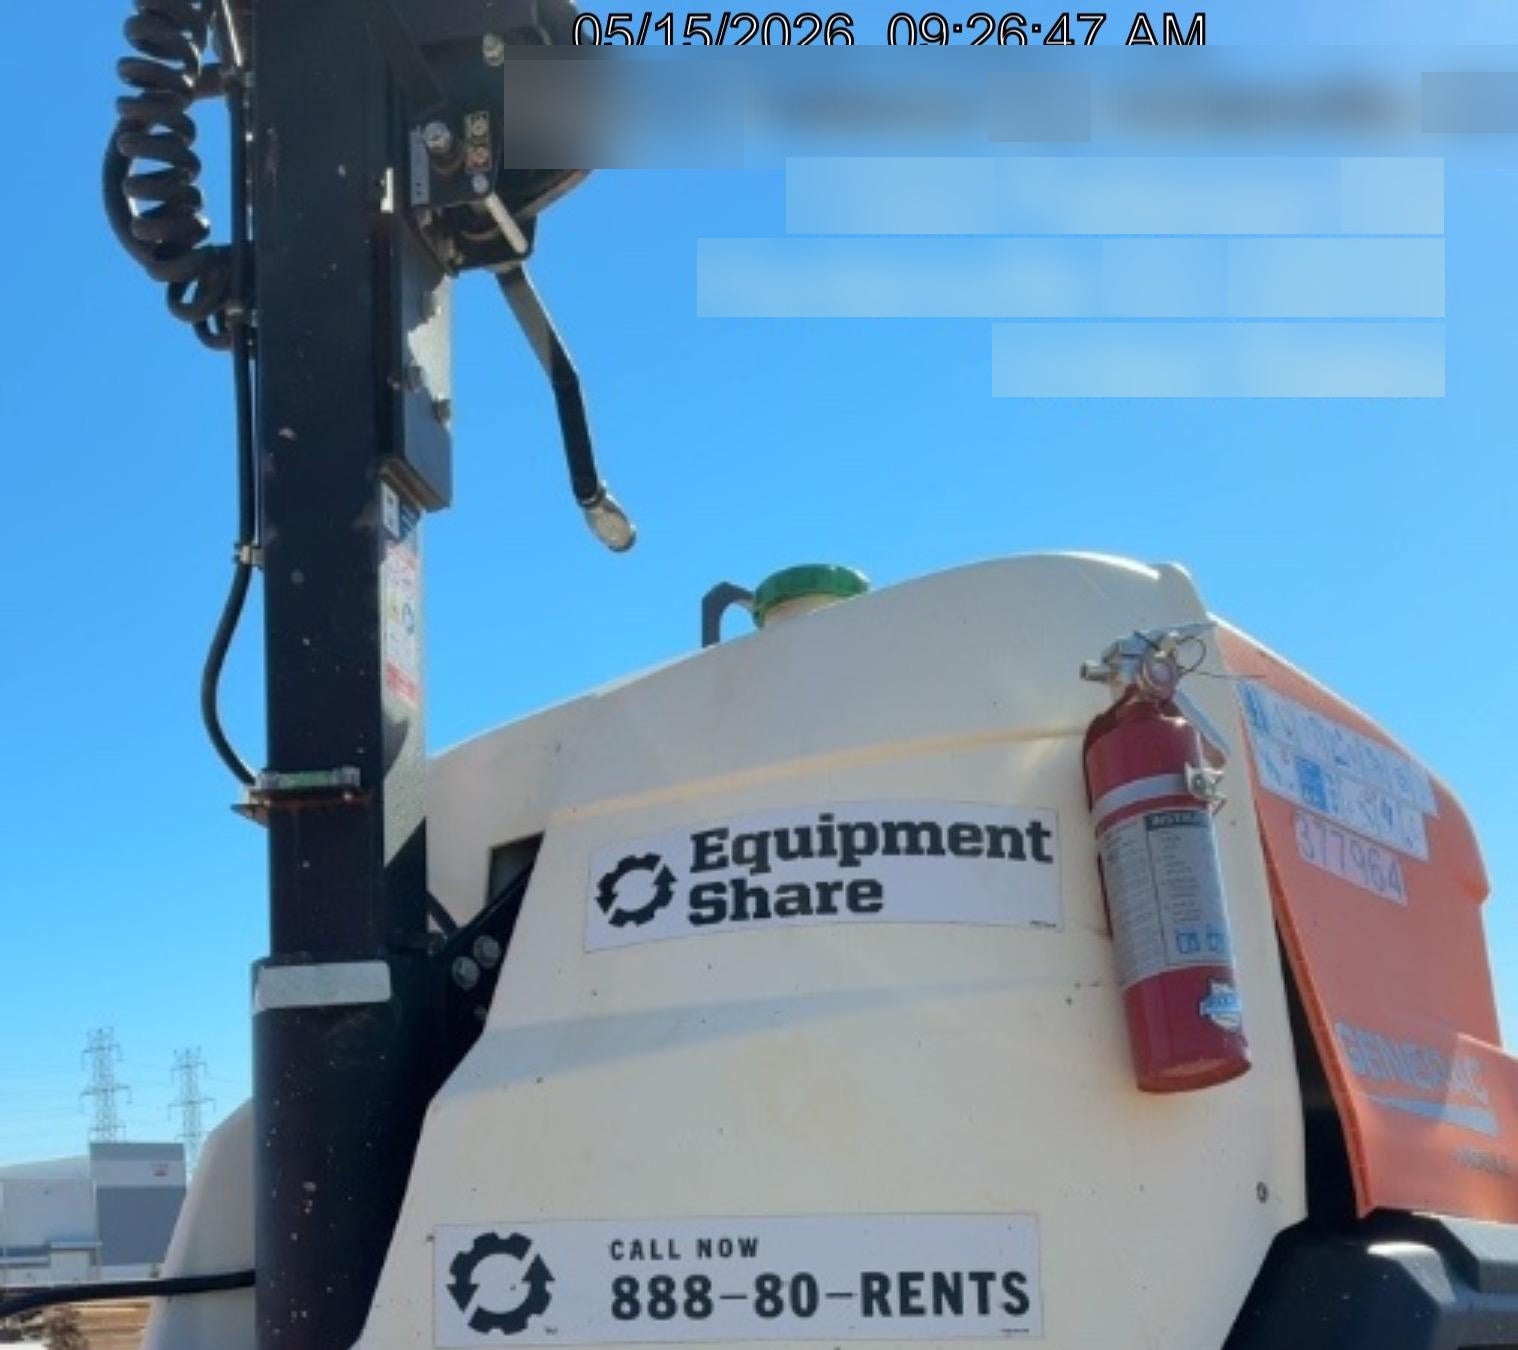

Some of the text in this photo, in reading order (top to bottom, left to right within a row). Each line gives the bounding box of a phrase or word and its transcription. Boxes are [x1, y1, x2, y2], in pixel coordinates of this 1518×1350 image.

[689, 813, 1054, 875] Equipment
[688, 878, 884, 926] Share
[609, 1237, 760, 1262] CALL NOW
[611, 1270, 1031, 1321] 888-80-RENTS
